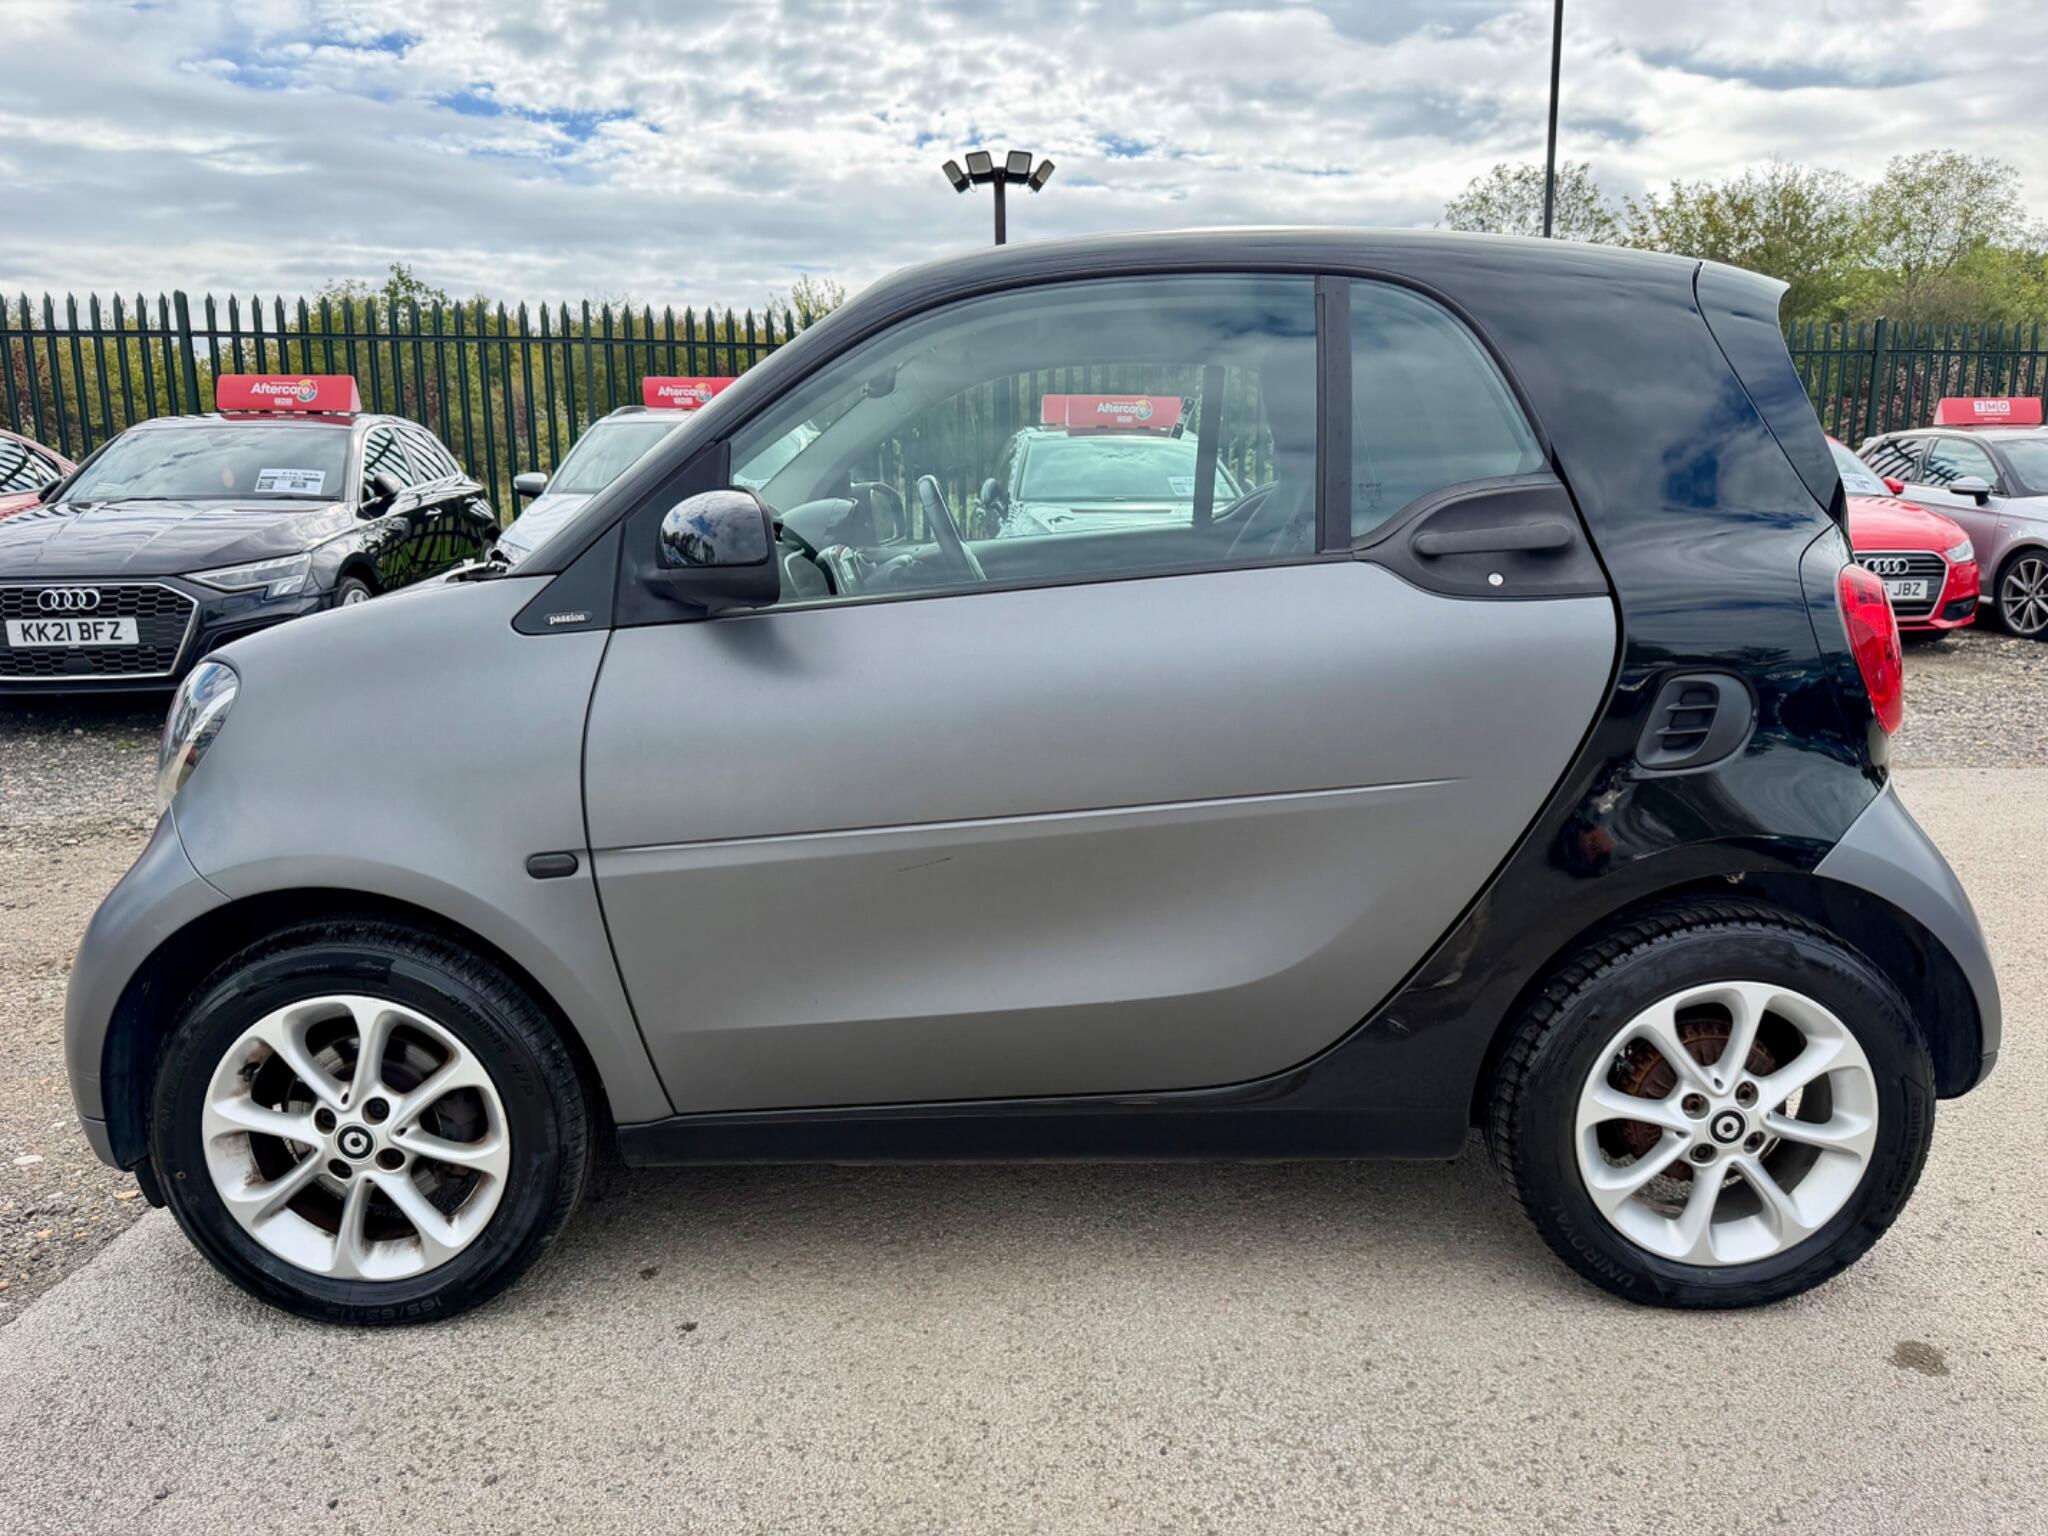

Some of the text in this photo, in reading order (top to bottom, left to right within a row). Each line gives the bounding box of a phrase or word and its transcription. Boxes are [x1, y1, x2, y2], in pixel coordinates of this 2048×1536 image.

[250, 382, 310, 395] Aftercare
[657, 385, 706, 397] Aftercare
[1096, 402, 1147, 413] Aftercare
[1893, 582, 1921, 596] JBZ
[550, 612, 585, 625] passion
[21, 621, 123, 642] KK21 BFZ
[1549, 1199, 1635, 1288] UNIROYAL
